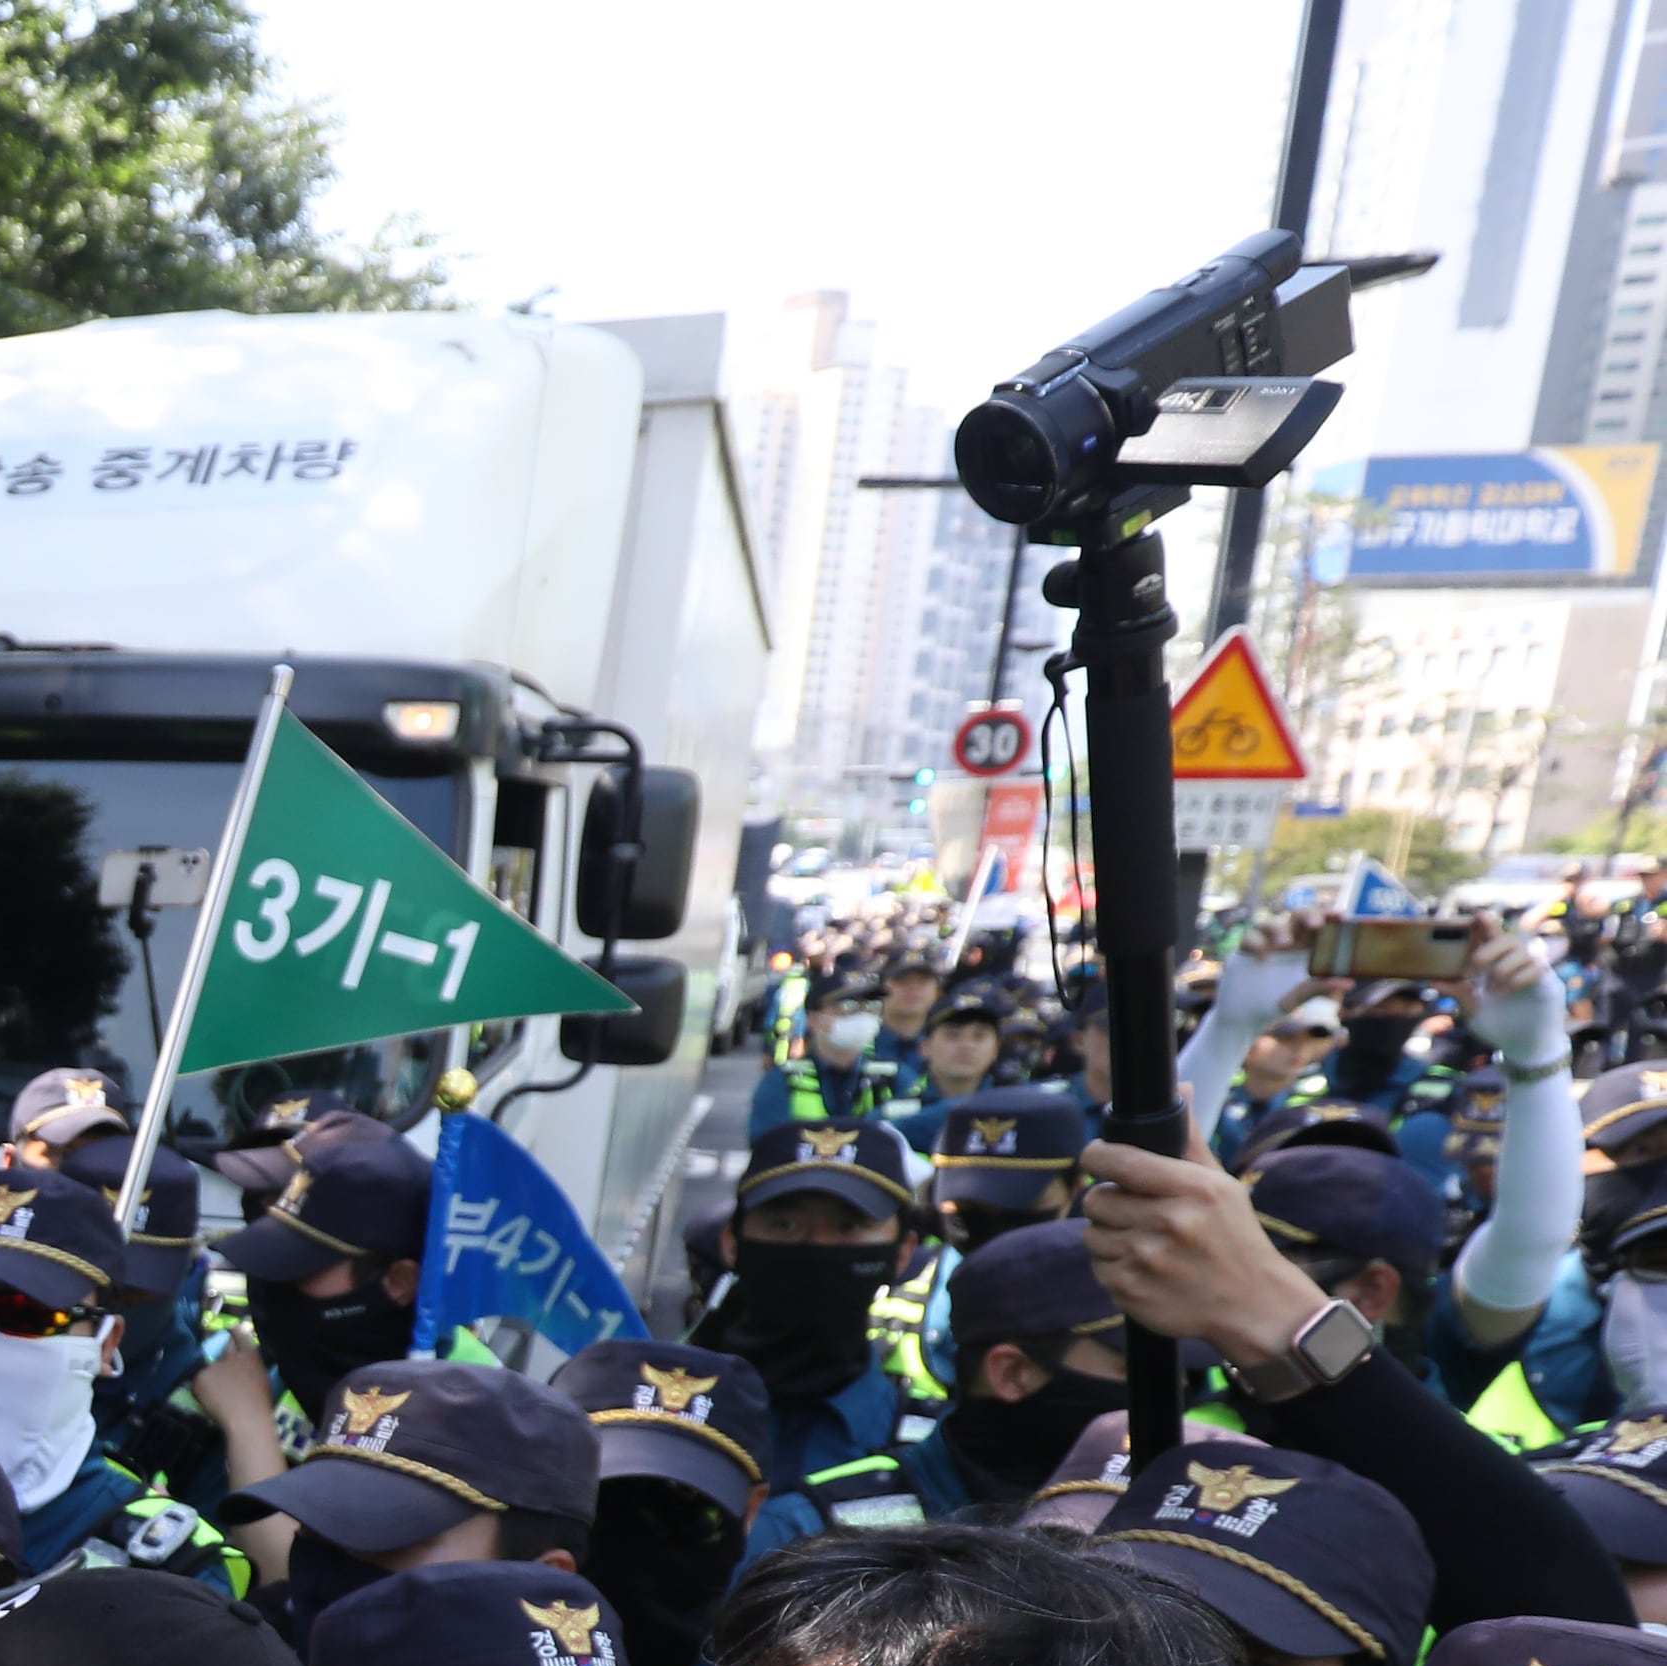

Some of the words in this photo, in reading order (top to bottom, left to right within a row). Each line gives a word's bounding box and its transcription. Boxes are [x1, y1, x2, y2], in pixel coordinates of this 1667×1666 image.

[91, 438, 358, 491] 중계차량
[966, 723, 1019, 765] 30
[233, 856, 482, 1003] 3기-1
